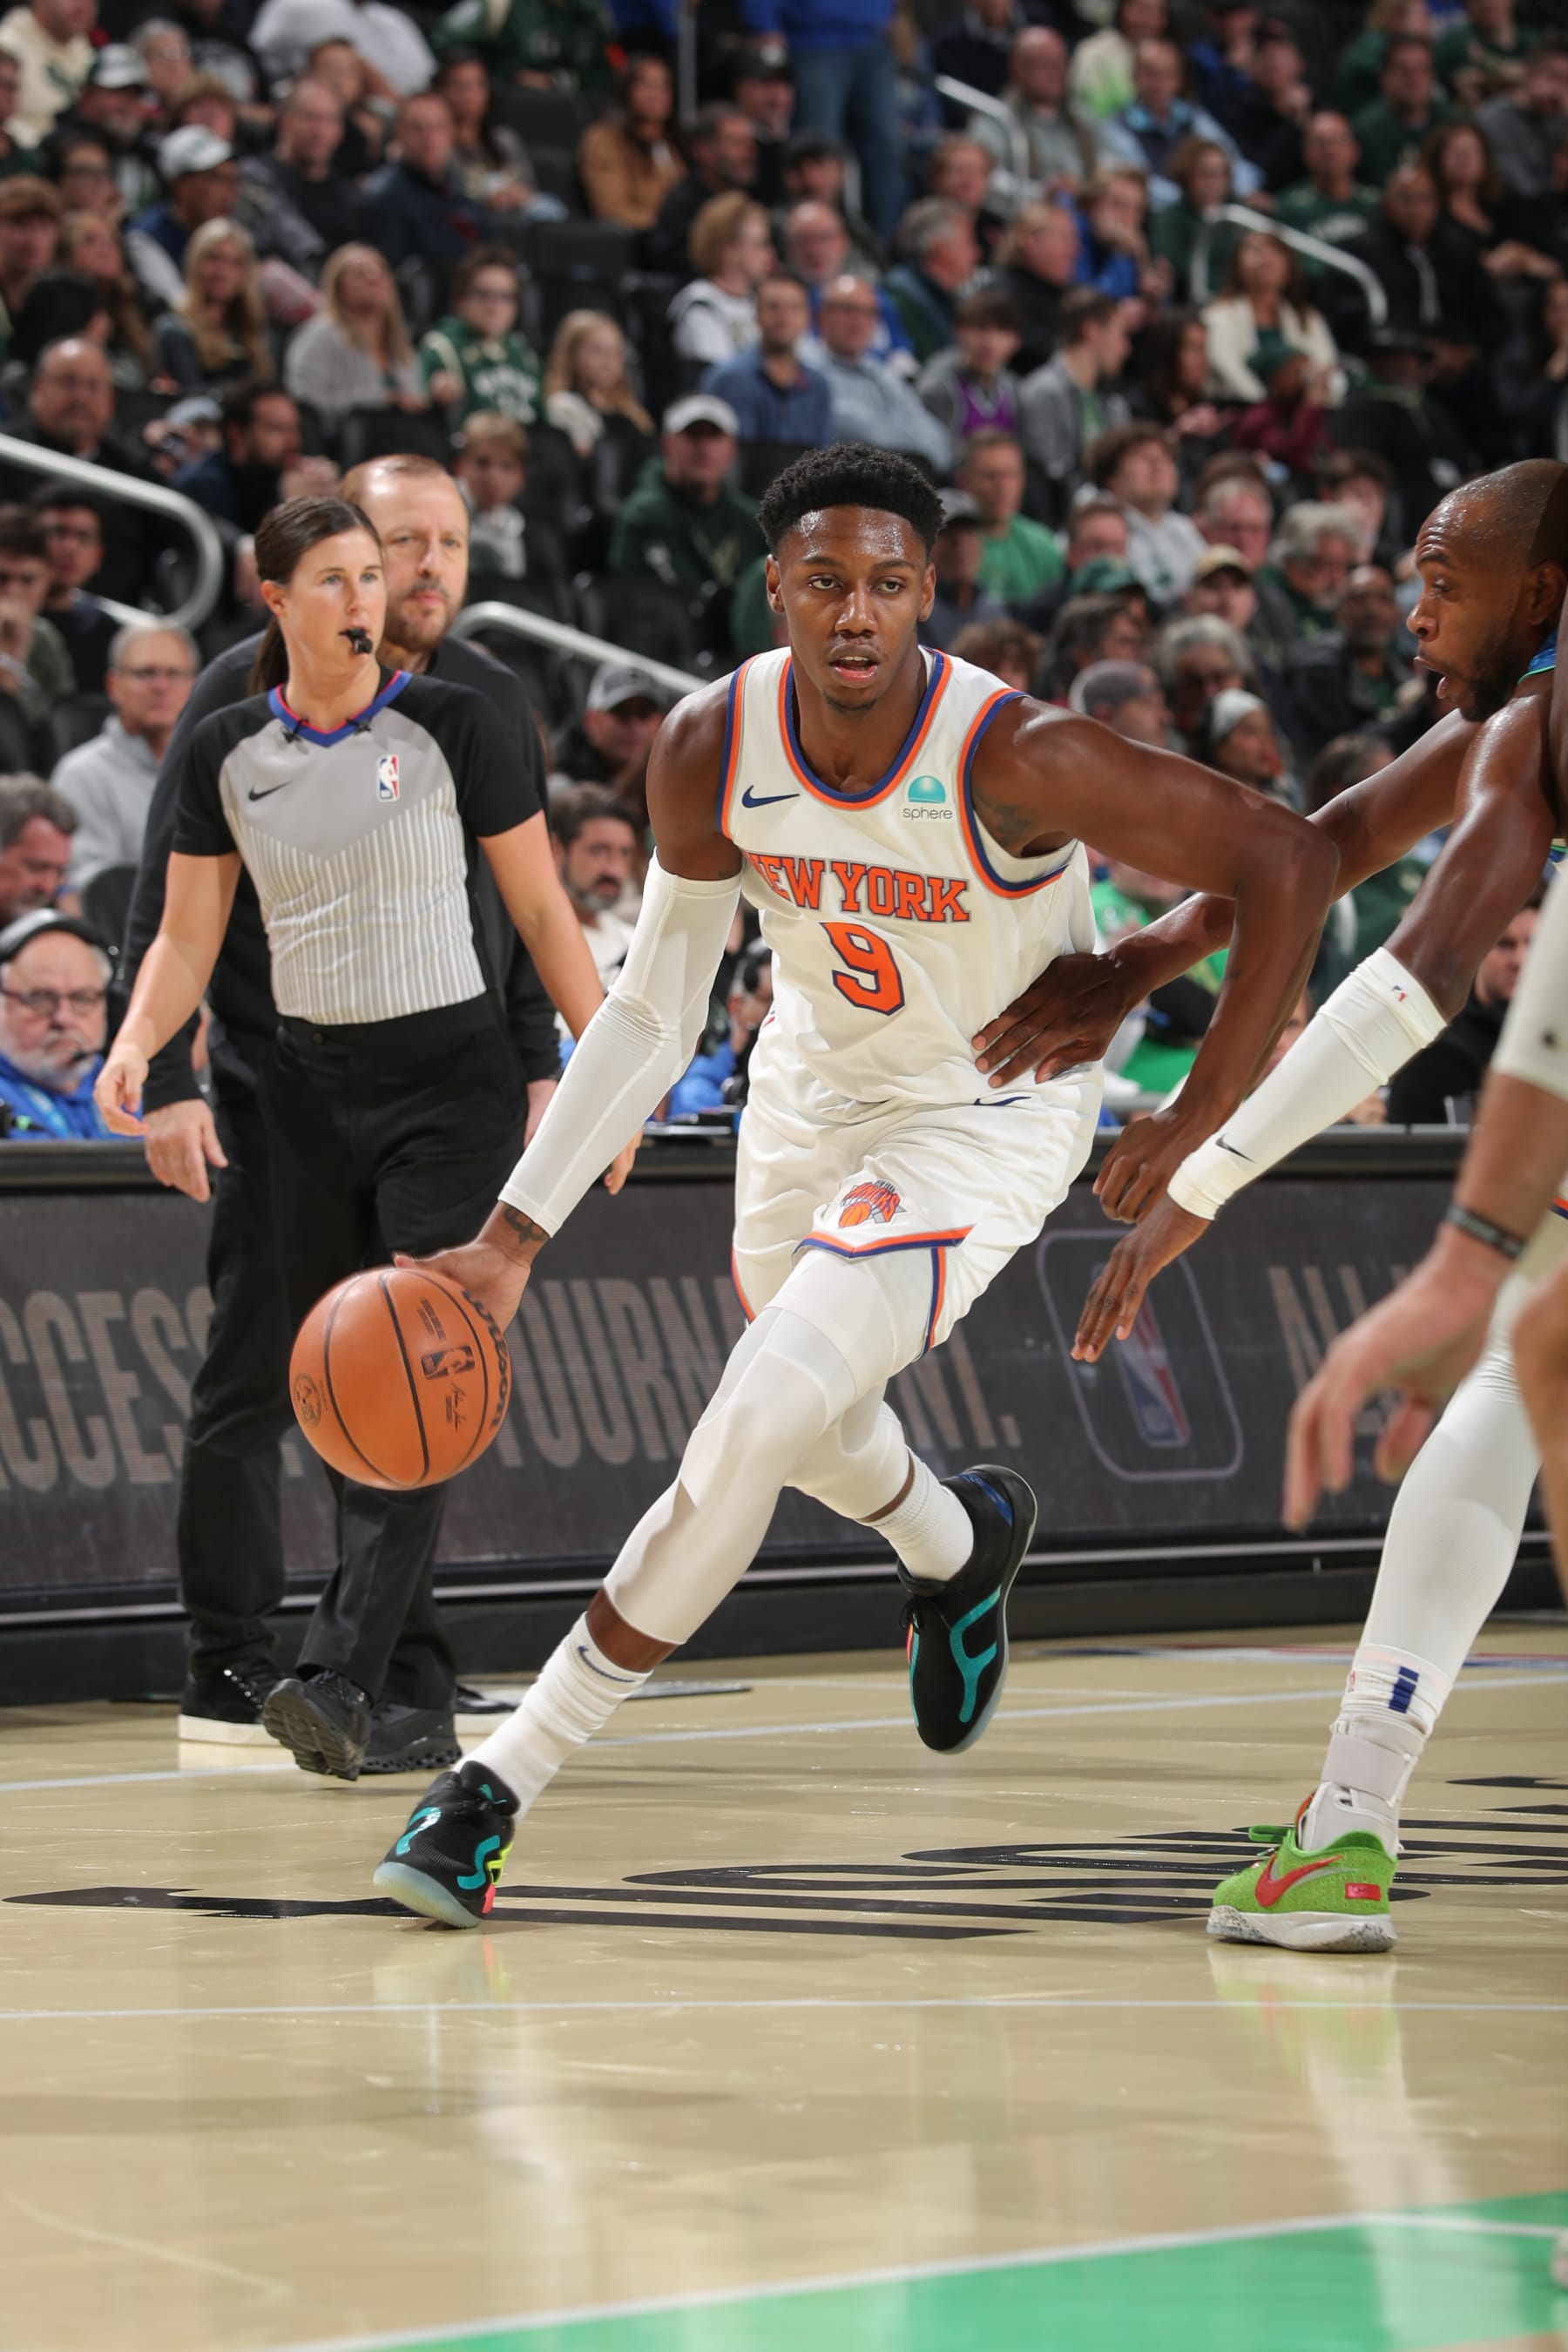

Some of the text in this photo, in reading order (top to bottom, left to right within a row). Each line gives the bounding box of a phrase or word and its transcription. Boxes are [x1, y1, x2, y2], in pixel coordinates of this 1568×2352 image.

[902, 807, 953, 821] sphere
[830, 860, 970, 922] YORK
[819, 922, 905, 1016] 9
